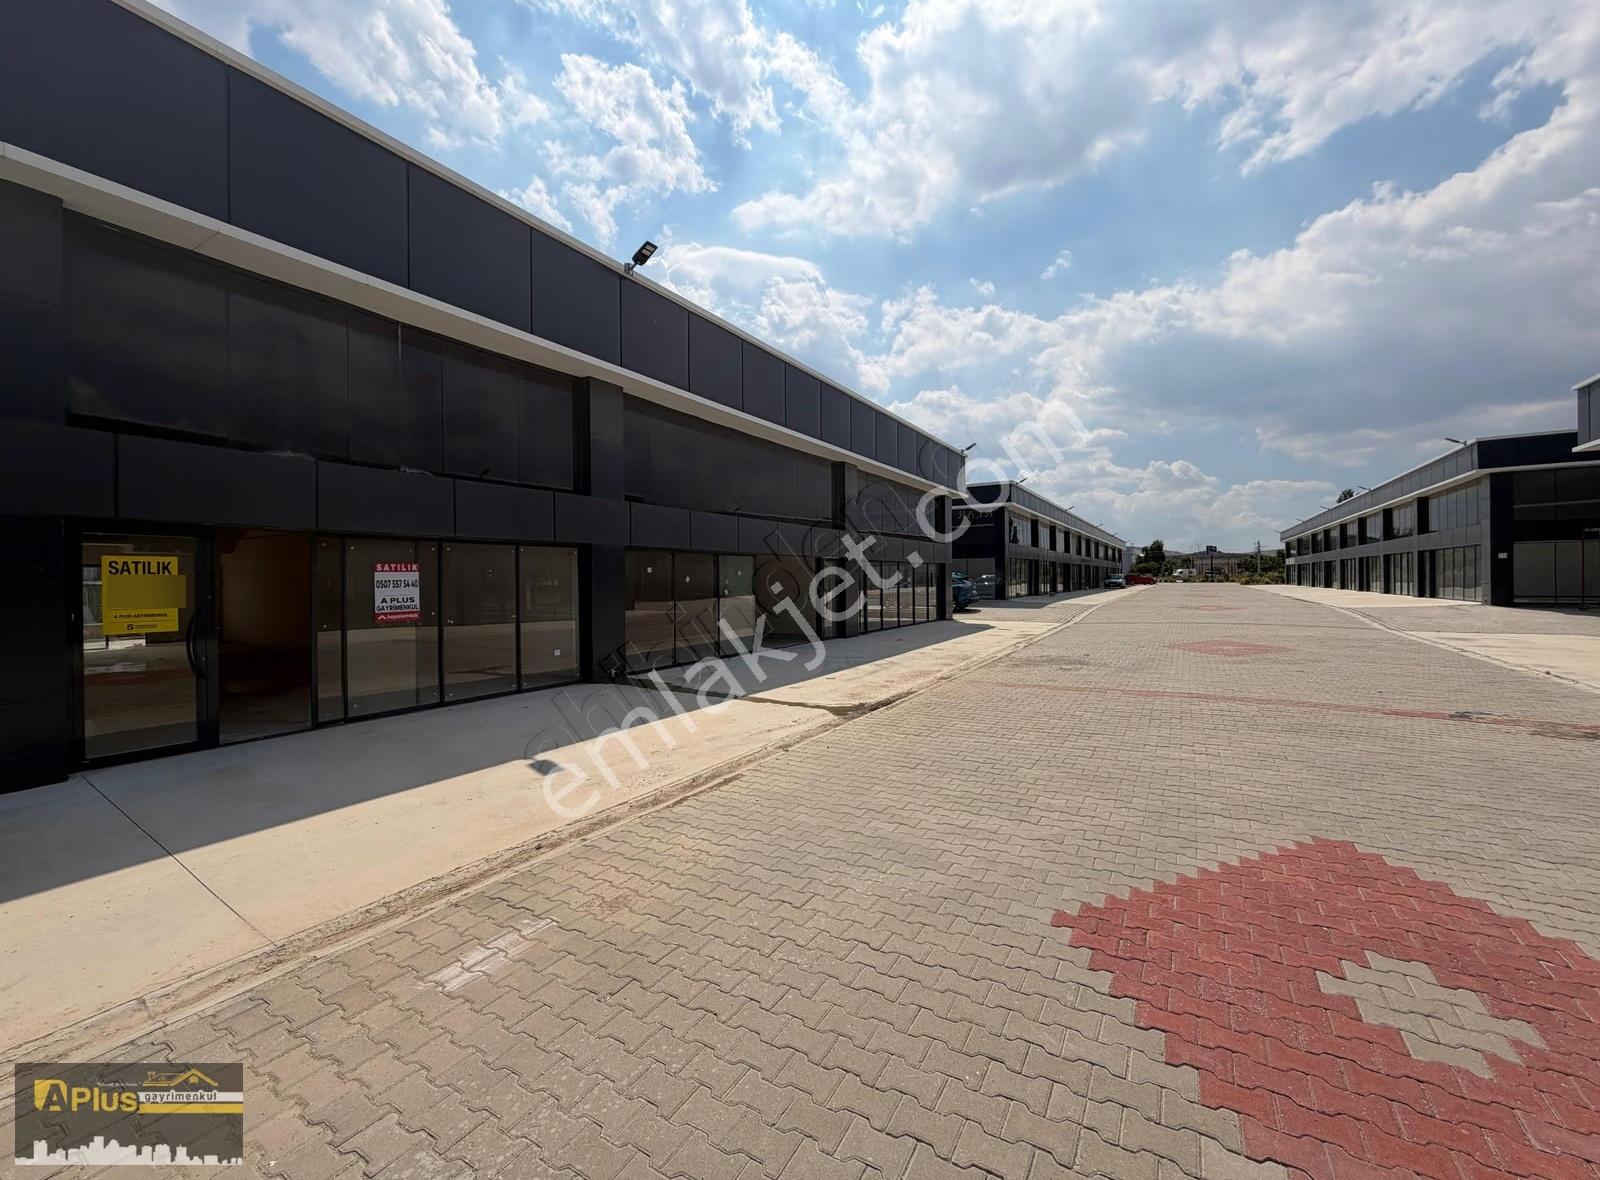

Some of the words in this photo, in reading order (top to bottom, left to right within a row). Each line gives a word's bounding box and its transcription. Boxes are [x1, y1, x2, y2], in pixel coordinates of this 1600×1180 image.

[108, 560, 172, 575] SATILIK
[376, 563, 418, 571] SATILIK
[376, 580, 391, 588] 0507
[392, 579, 402, 588] 557
[390, 596, 415, 604] PLUS
